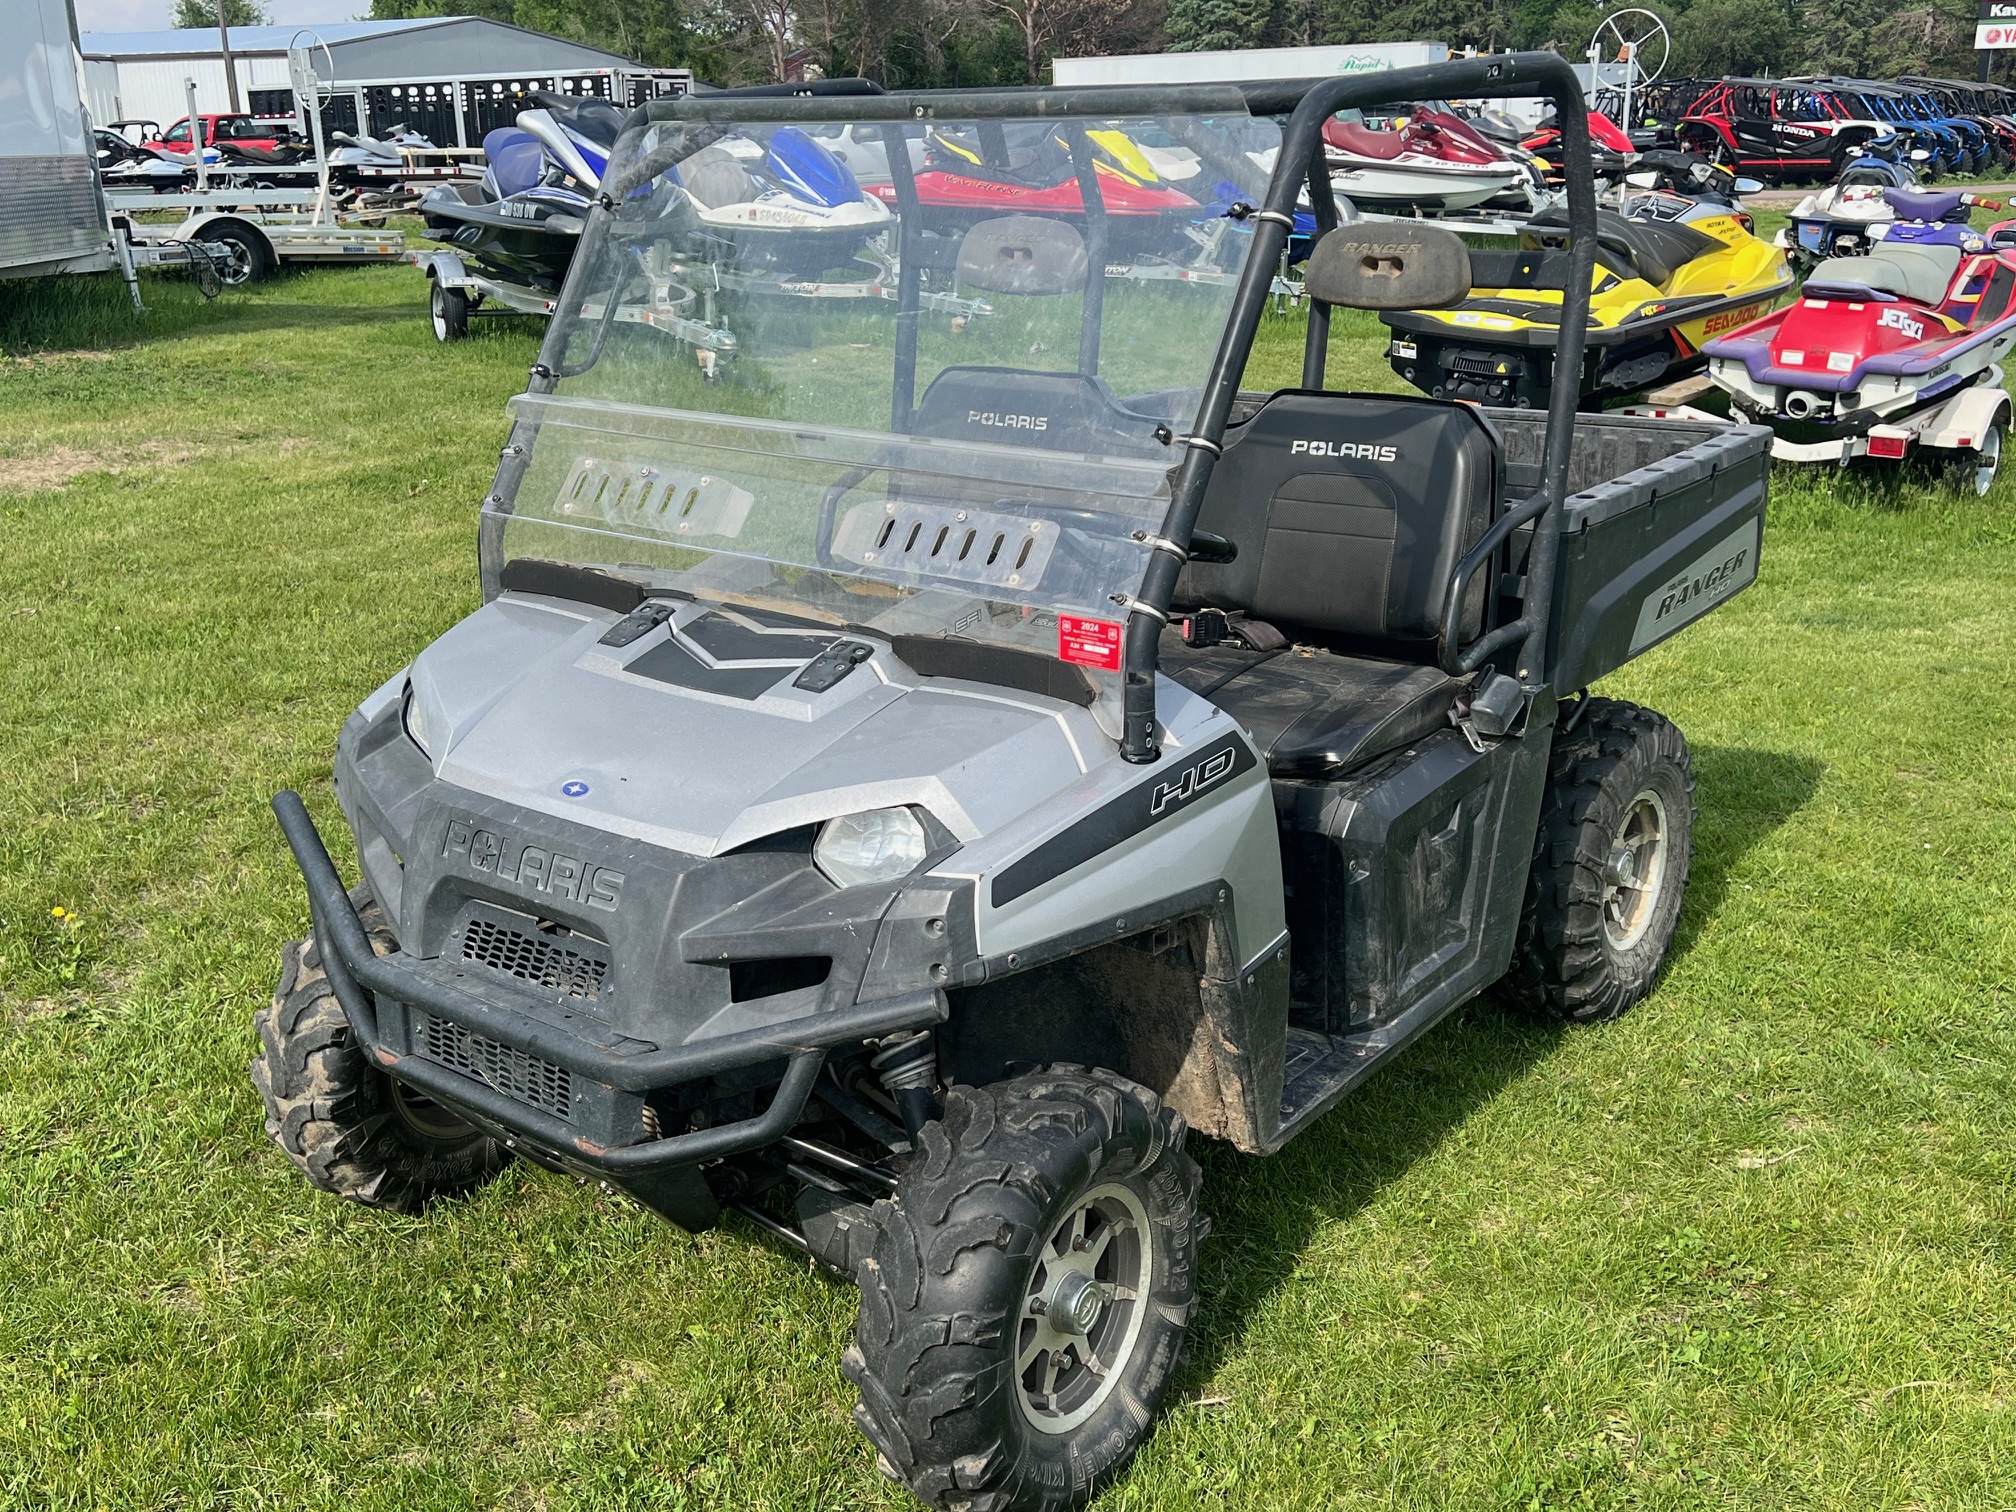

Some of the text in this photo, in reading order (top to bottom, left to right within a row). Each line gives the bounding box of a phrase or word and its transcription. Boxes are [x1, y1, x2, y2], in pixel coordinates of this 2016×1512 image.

[1344, 59, 1380, 71] Rapid
[1772, 123, 1815, 138] HONDA
[1342, 242, 1422, 255] RANGER
[967, 410, 1048, 431] POLARIS
[1291, 440, 1398, 463] POLARIS
[1654, 547, 1748, 623] RANGER
[1708, 577, 1733, 601] HD
[954, 608, 982, 634] EFI
[1080, 621, 1100, 633] 2024
[1150, 746, 1237, 816] HD
[441, 819, 627, 913] POLARIS
